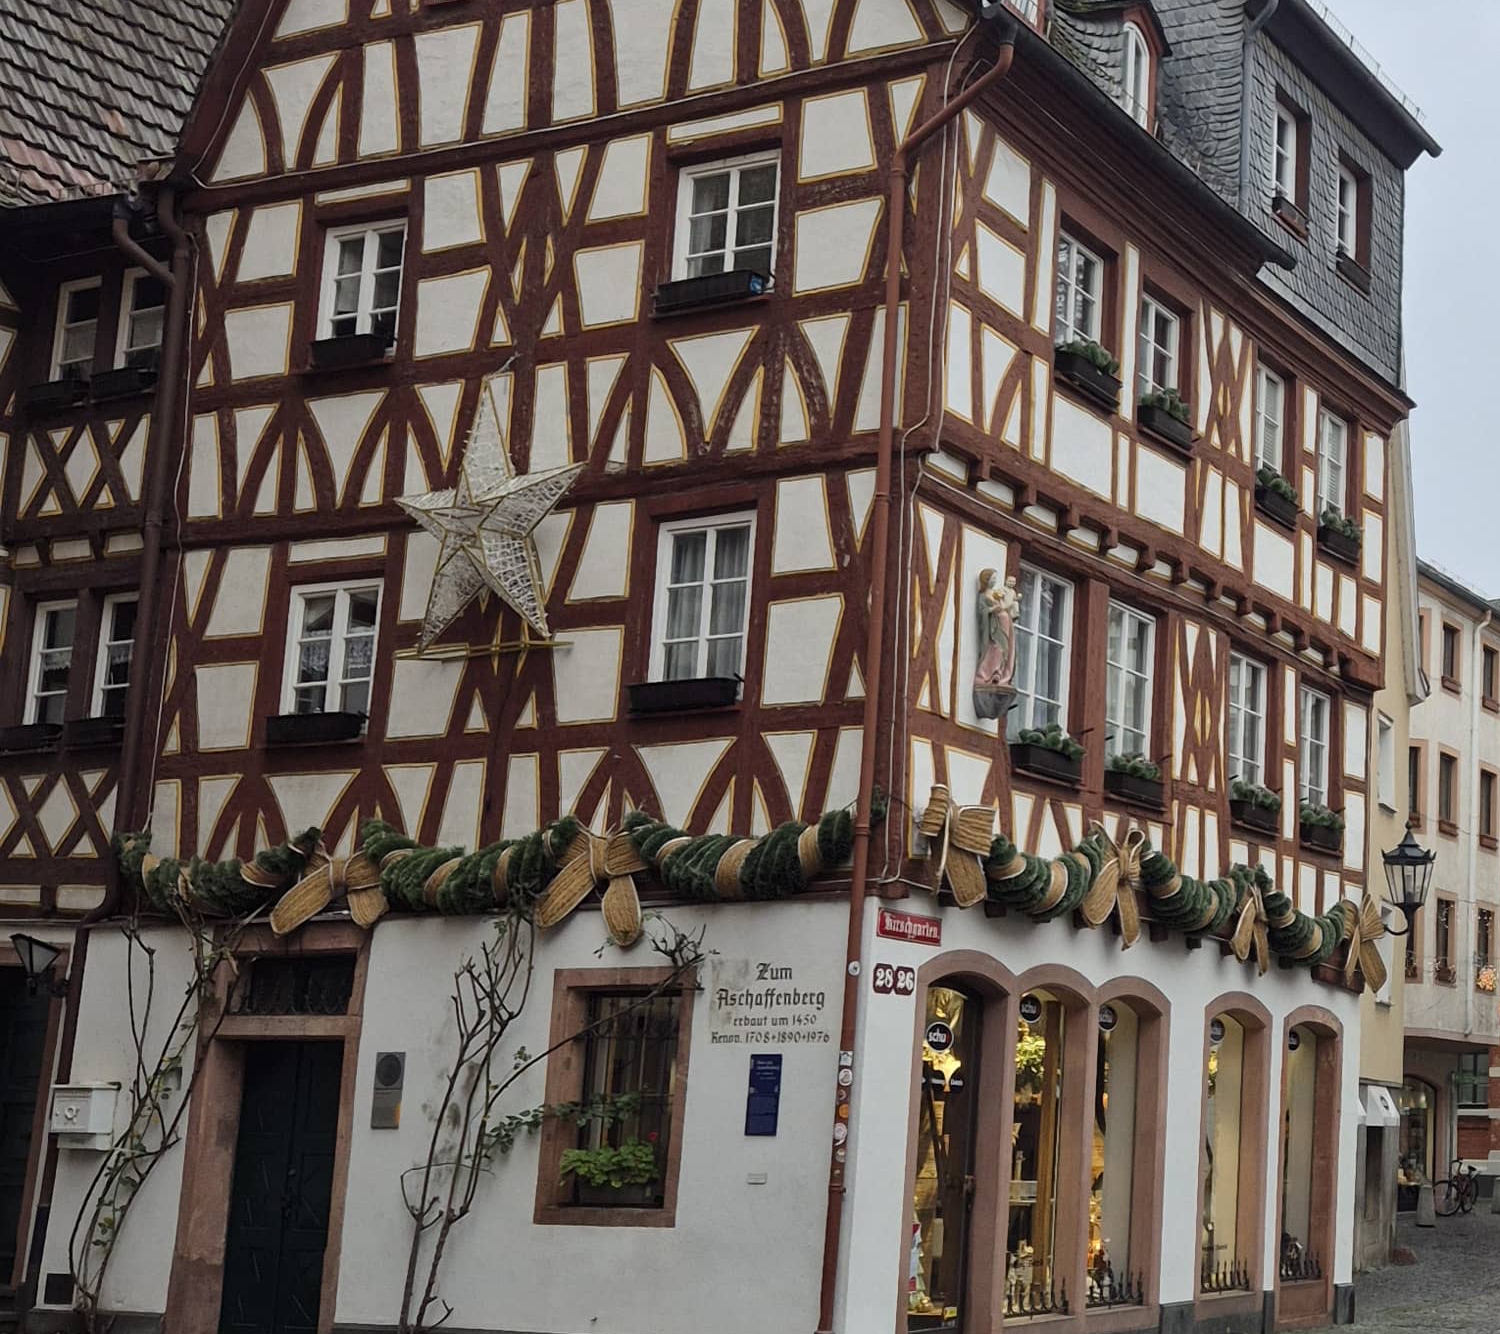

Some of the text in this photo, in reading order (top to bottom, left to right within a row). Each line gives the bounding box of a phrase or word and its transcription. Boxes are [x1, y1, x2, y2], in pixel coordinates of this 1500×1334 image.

[756, 963, 792, 981] Zum
[876, 968, 893, 988] 28
[897, 970, 914, 991] 26
[716, 988, 825, 1011] Aschaffenberg
[733, 1014, 817, 1027] erbaut um 1450
